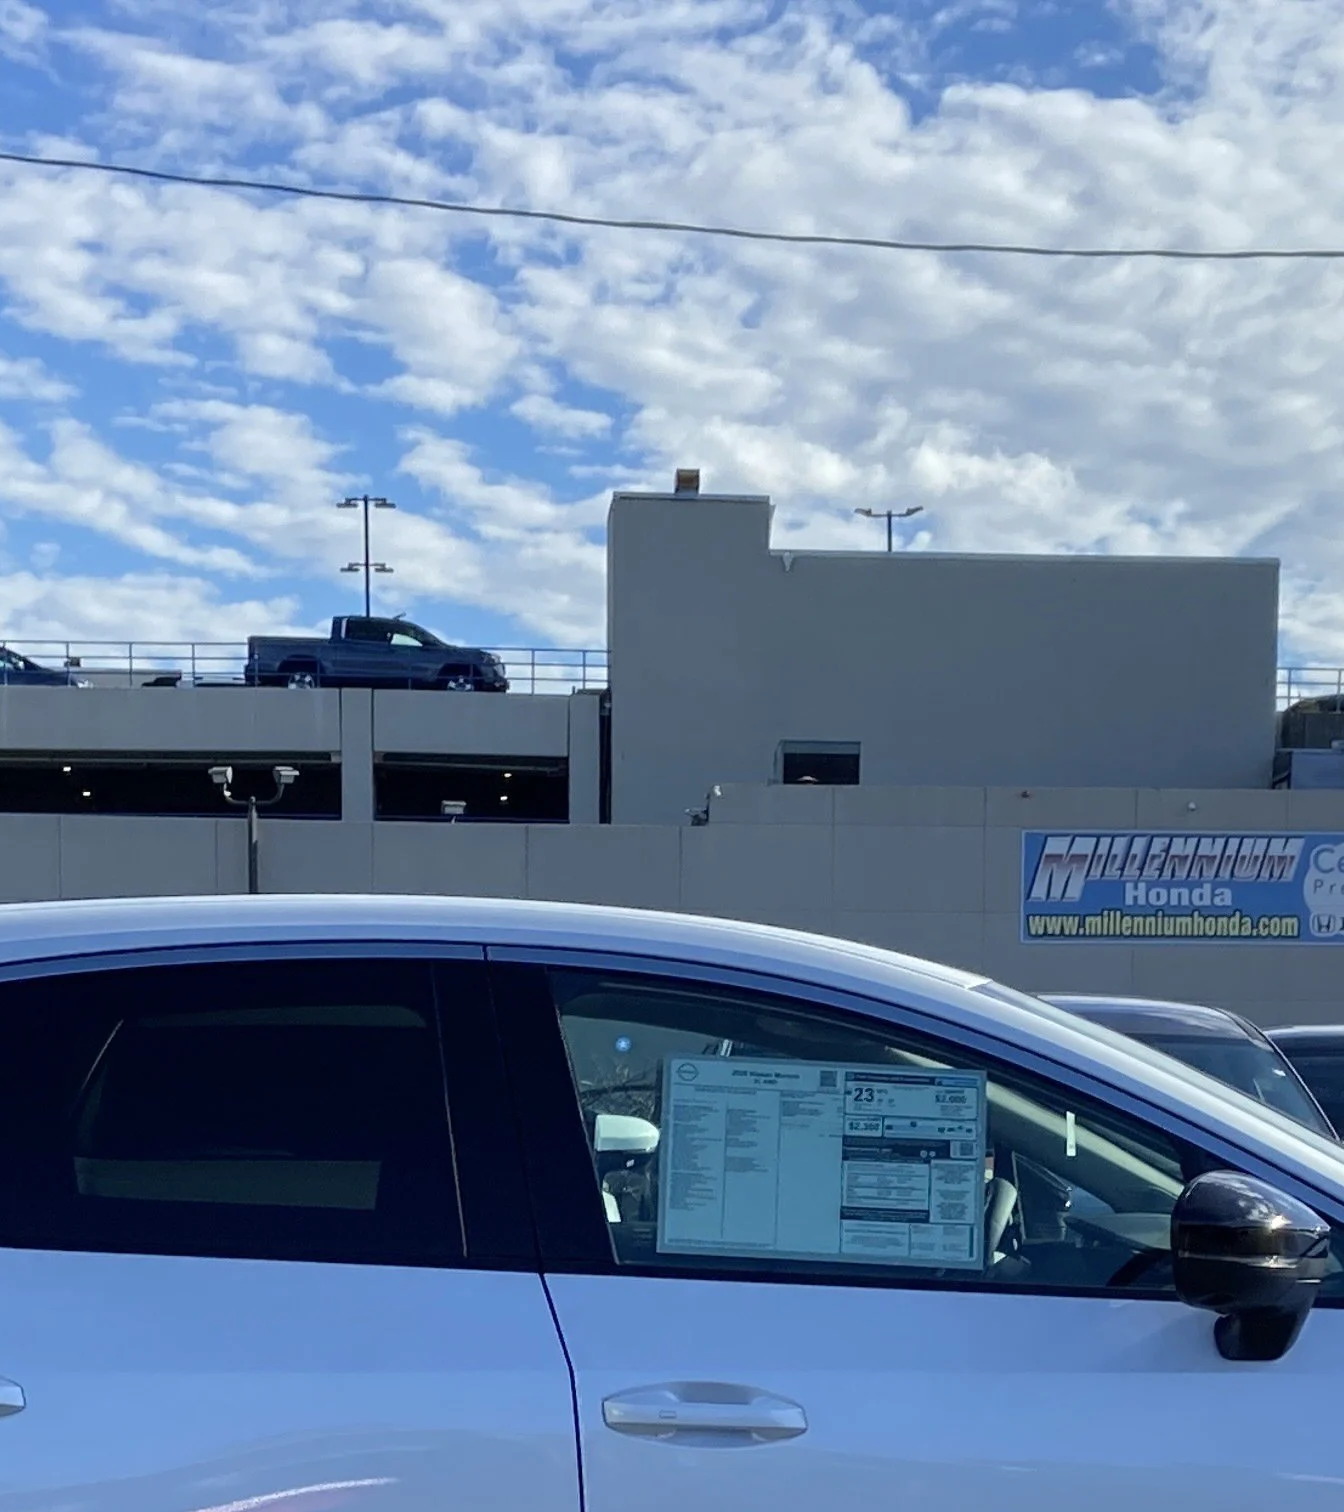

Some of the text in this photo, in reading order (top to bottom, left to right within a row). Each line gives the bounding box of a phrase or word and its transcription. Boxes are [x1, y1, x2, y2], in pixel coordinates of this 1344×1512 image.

[1027, 835, 1305, 901] MILLENNIUM
[1124, 882, 1233, 906] Honda
[1028, 910, 1300, 937] www.millenniumhonda.com
[854, 1087, 874, 1103] 23
